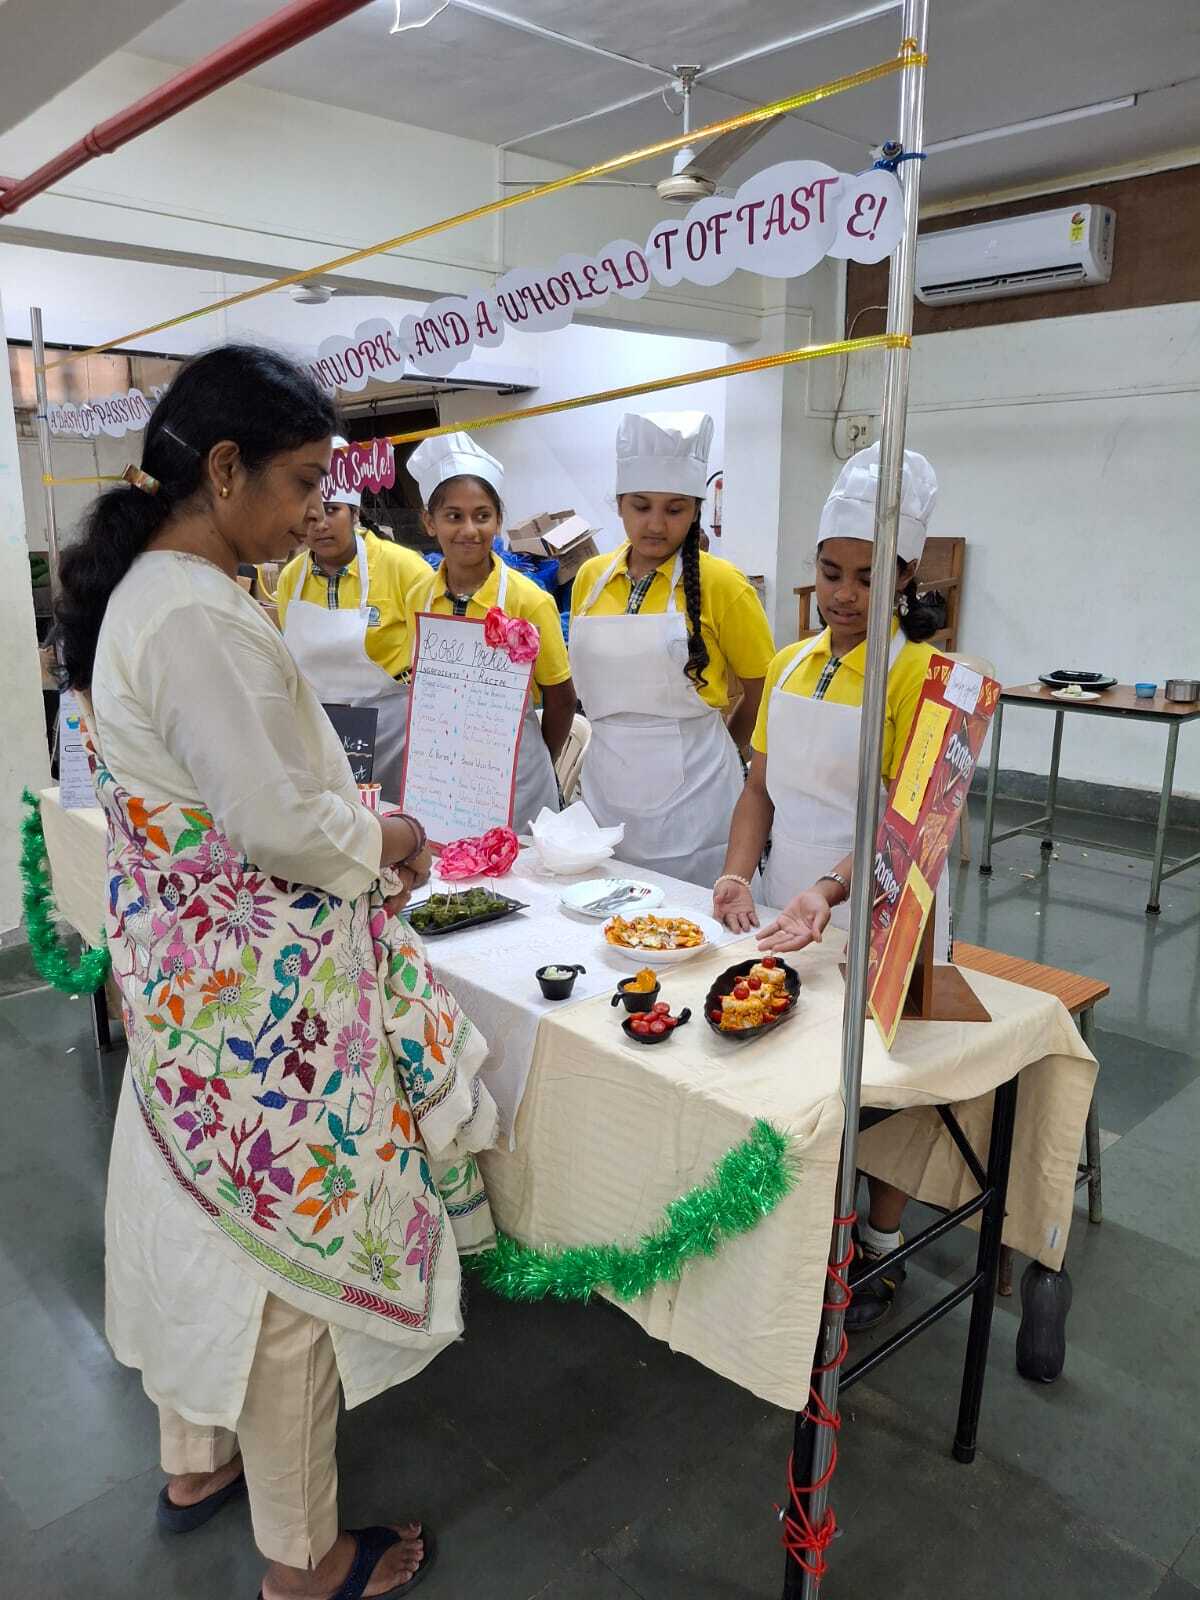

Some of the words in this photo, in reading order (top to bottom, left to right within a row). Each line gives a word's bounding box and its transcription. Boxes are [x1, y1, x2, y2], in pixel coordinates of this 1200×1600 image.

[476, 301, 498, 338] A
[497, 265, 609, 323] WHOLE
[686, 211, 732, 262] OF
[351, 441, 391, 486] Smile!
